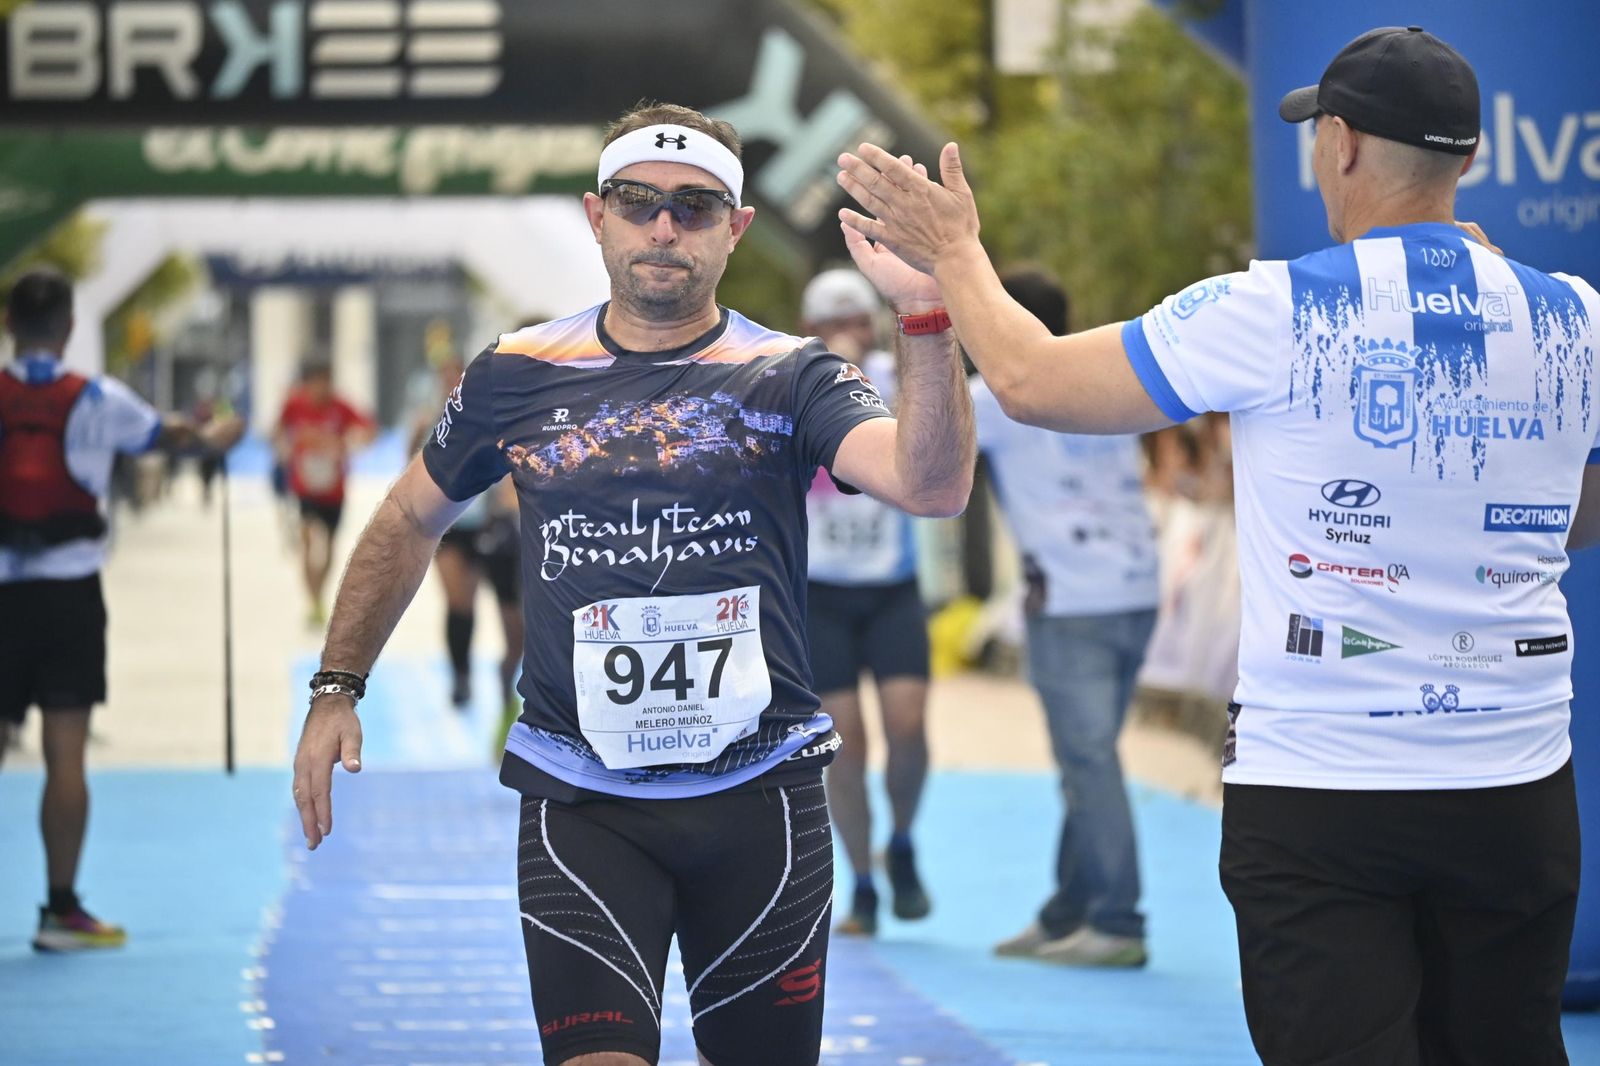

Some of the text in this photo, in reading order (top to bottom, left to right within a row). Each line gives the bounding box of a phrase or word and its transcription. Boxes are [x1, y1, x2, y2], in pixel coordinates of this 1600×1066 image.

[1424, 134, 1454, 145] UNDER
[1368, 277, 1512, 317] Huelva
[1431, 415, 1545, 441] HUELVA
[1308, 507, 1391, 529] HYUNDAI
[1490, 507, 1568, 526] DECATHLON
[1325, 527, 1371, 545] Syrluz
[584, 630, 622, 640] HUELVA
[664, 623, 699, 632] HUELVA
[716, 620, 750, 633] HUELVA
[604, 637, 733, 705] 947
[642, 703, 705, 715] ANTONIO DANIEL
[635, 713, 713, 729] MELERO MUÑOZ
[627, 729, 712, 753] Huelva
